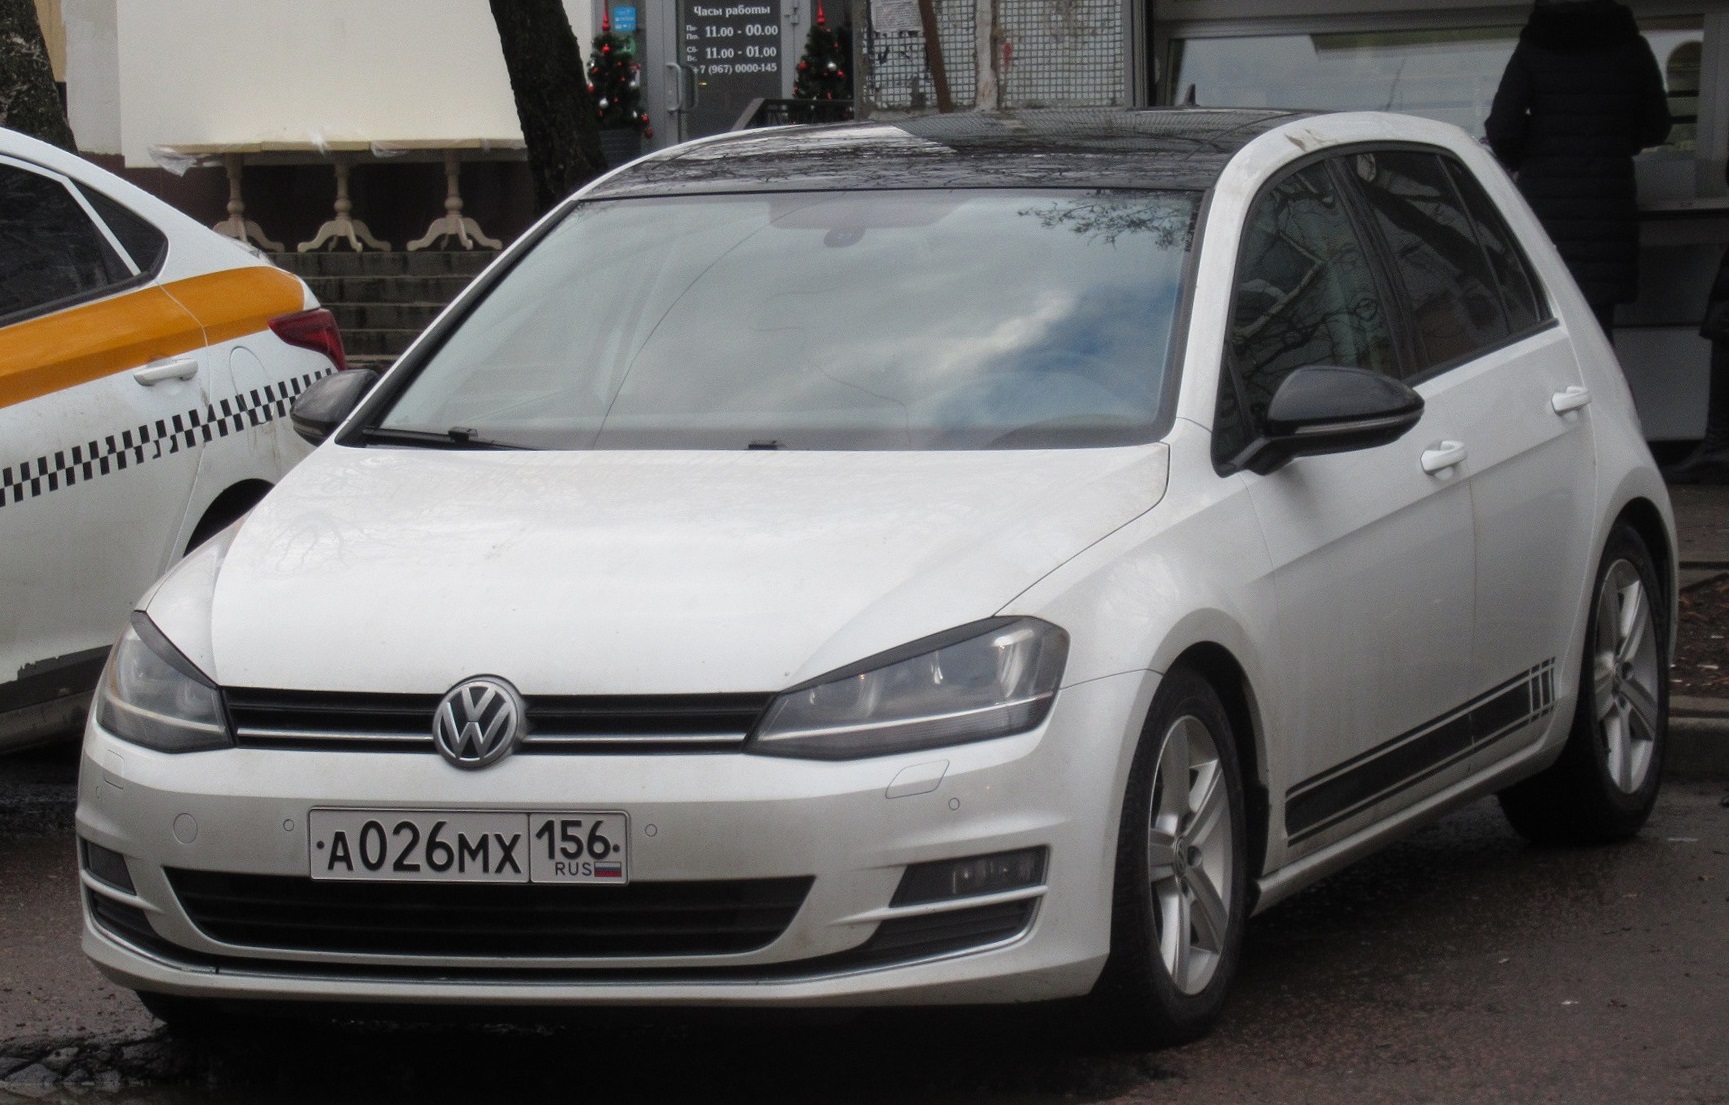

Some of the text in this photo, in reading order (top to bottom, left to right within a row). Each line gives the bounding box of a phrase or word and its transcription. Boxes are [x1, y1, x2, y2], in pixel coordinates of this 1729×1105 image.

[693, 5, 771, 18] Часы работы
[705, 26, 734, 37] 11.00
[745, 24, 779, 36] 00.00
[705, 47, 735, 59] 11.00
[746, 46, 777, 58] 01.00
[708, 64, 733, 75] (967)
[735, 63, 777, 73] 0000-145
[328, 819, 611, 874] А026МХ 156
[555, 860, 593, 876] RUS
